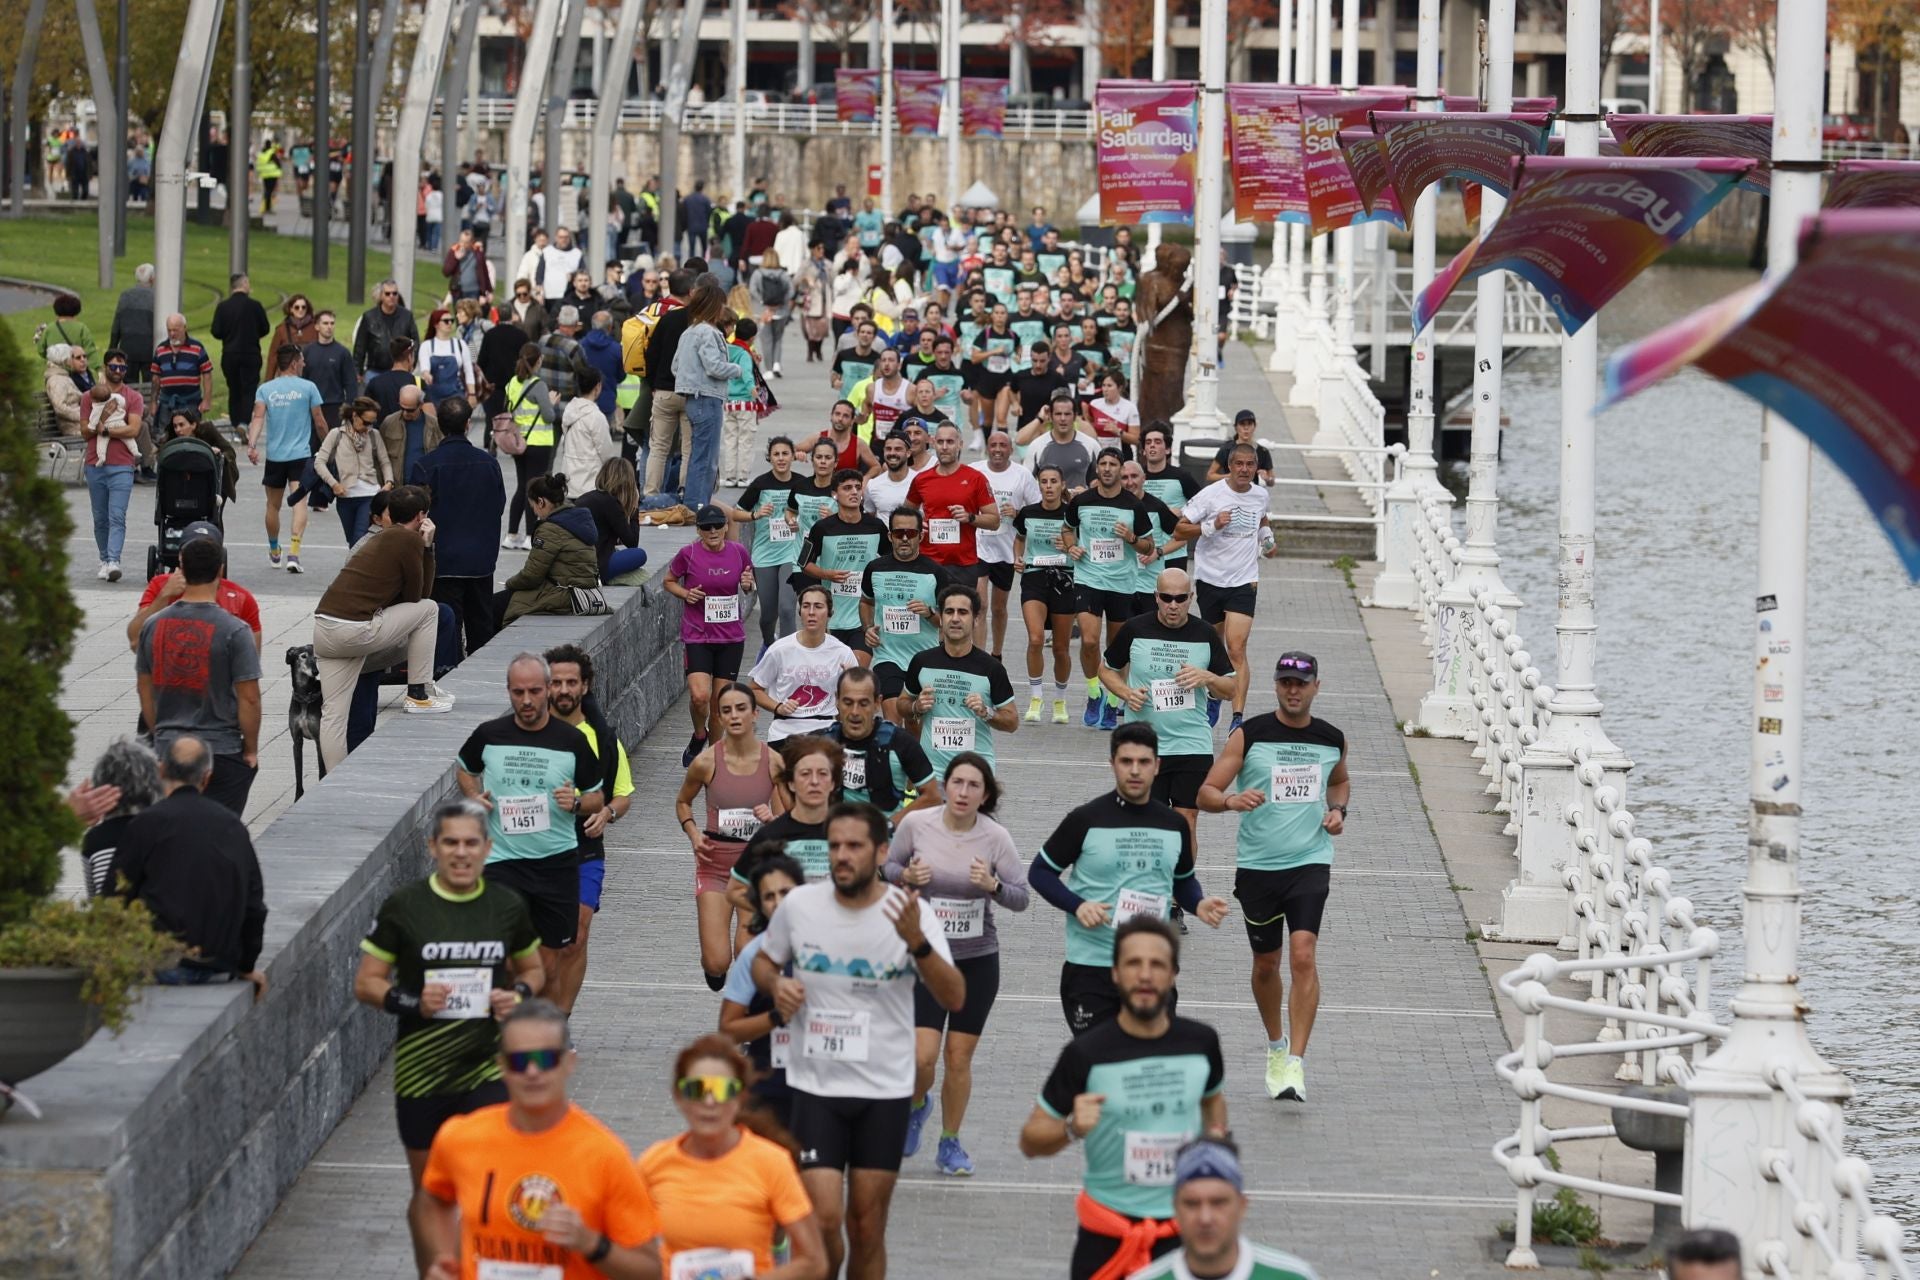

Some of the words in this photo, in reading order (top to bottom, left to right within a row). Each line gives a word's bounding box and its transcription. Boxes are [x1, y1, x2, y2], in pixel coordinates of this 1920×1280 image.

[1100, 109, 1137, 128] Fair
[1304, 114, 1343, 134] Fair
[1101, 128, 1193, 152] Saturday
[1388, 126, 1539, 161] Saturday
[1308, 158, 1337, 170] Azaroak
[937, 532, 949, 540] 401
[1099, 550, 1116, 558] 2104
[839, 584, 857, 593] 3225
[715, 610, 732, 619] 1635
[891, 621, 910, 630] 1167
[1155, 688, 1173, 696] XXXVI
[1164, 695, 1184, 707] 1139
[934, 727, 952, 736] XXXVI
[942, 736, 964, 746] 1142
[842, 770, 865, 784] 2188
[1275, 775, 1296, 785] XXXVI
[1285, 785, 1309, 797] 2472
[502, 807, 521, 816] XXXVI
[512, 815, 535, 828] 1451
[723, 819, 743, 827] XXXVI
[731, 826, 754, 837] 2140
[1121, 901, 1143, 912] XXXVI
[943, 920, 970, 933] 2128
[823, 1036, 844, 1052] 761
